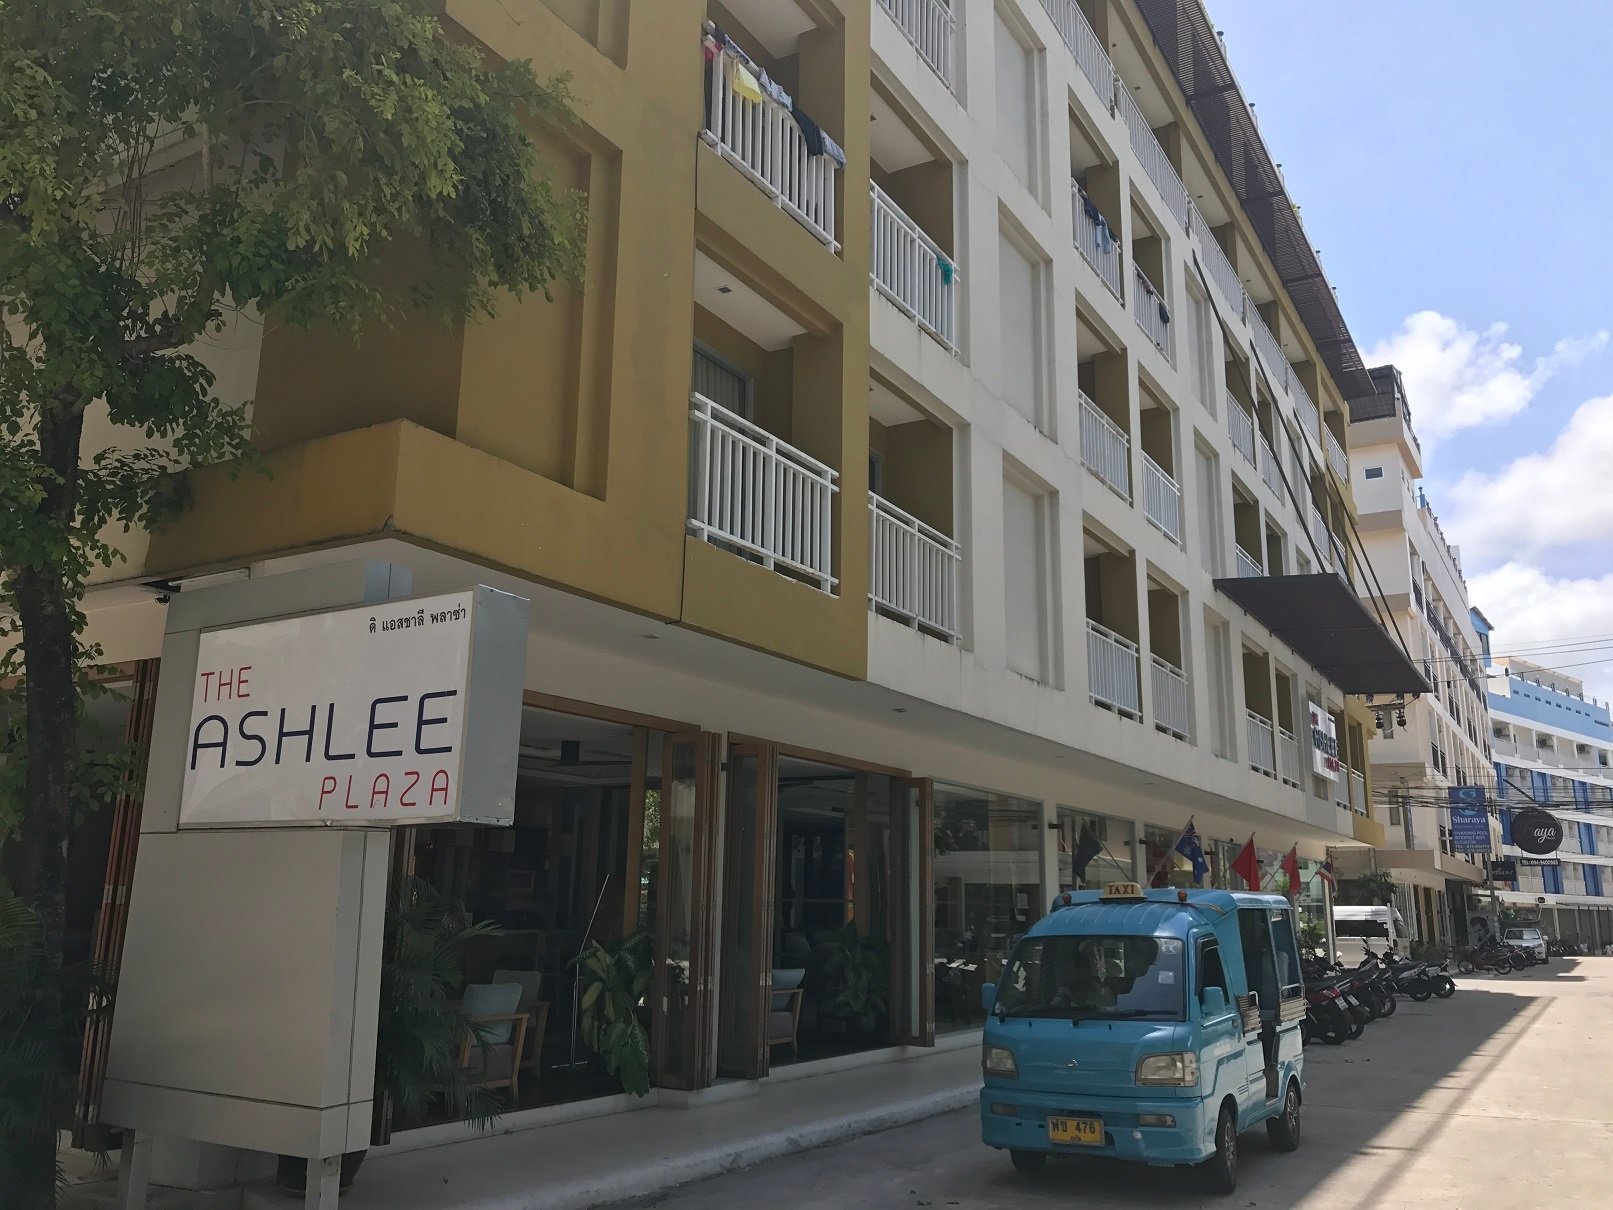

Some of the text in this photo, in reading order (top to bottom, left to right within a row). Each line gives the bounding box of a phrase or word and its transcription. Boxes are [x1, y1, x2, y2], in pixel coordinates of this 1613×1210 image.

[200, 666, 252, 703] THE
[190, 689, 457, 770] ASHLEE
[318, 769, 450, 810] PLAZA
[1452, 815, 1486, 825] Sharaya
[1534, 827, 1556, 844] aya
[1107, 884, 1136, 895] TAXI
[1075, 1121, 1096, 1135] 476
